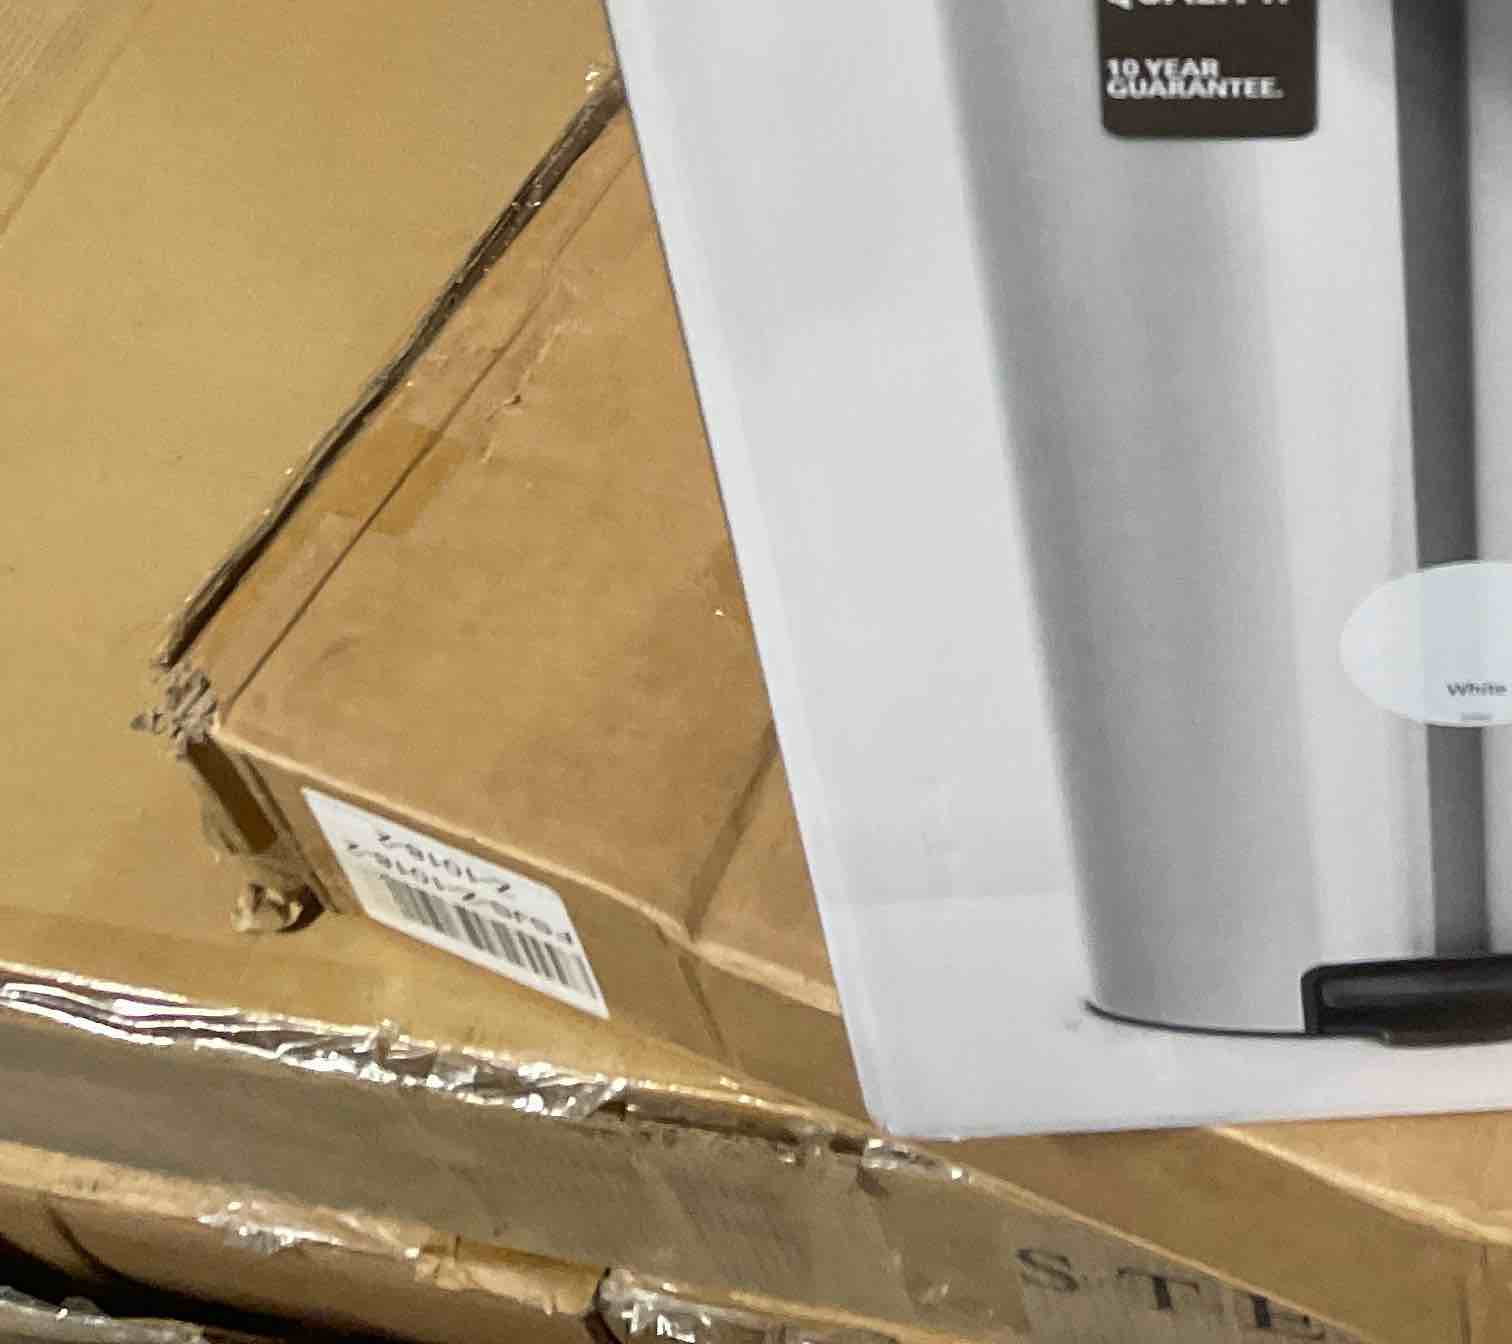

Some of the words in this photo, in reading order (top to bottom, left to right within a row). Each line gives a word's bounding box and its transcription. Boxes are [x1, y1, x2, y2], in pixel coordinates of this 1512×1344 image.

[1106, 57, 1141, 78] 10
[1144, 57, 1220, 78] YEAR
[1106, 77, 1285, 99] GUARANTEE.
[1446, 682, 1508, 696] White
